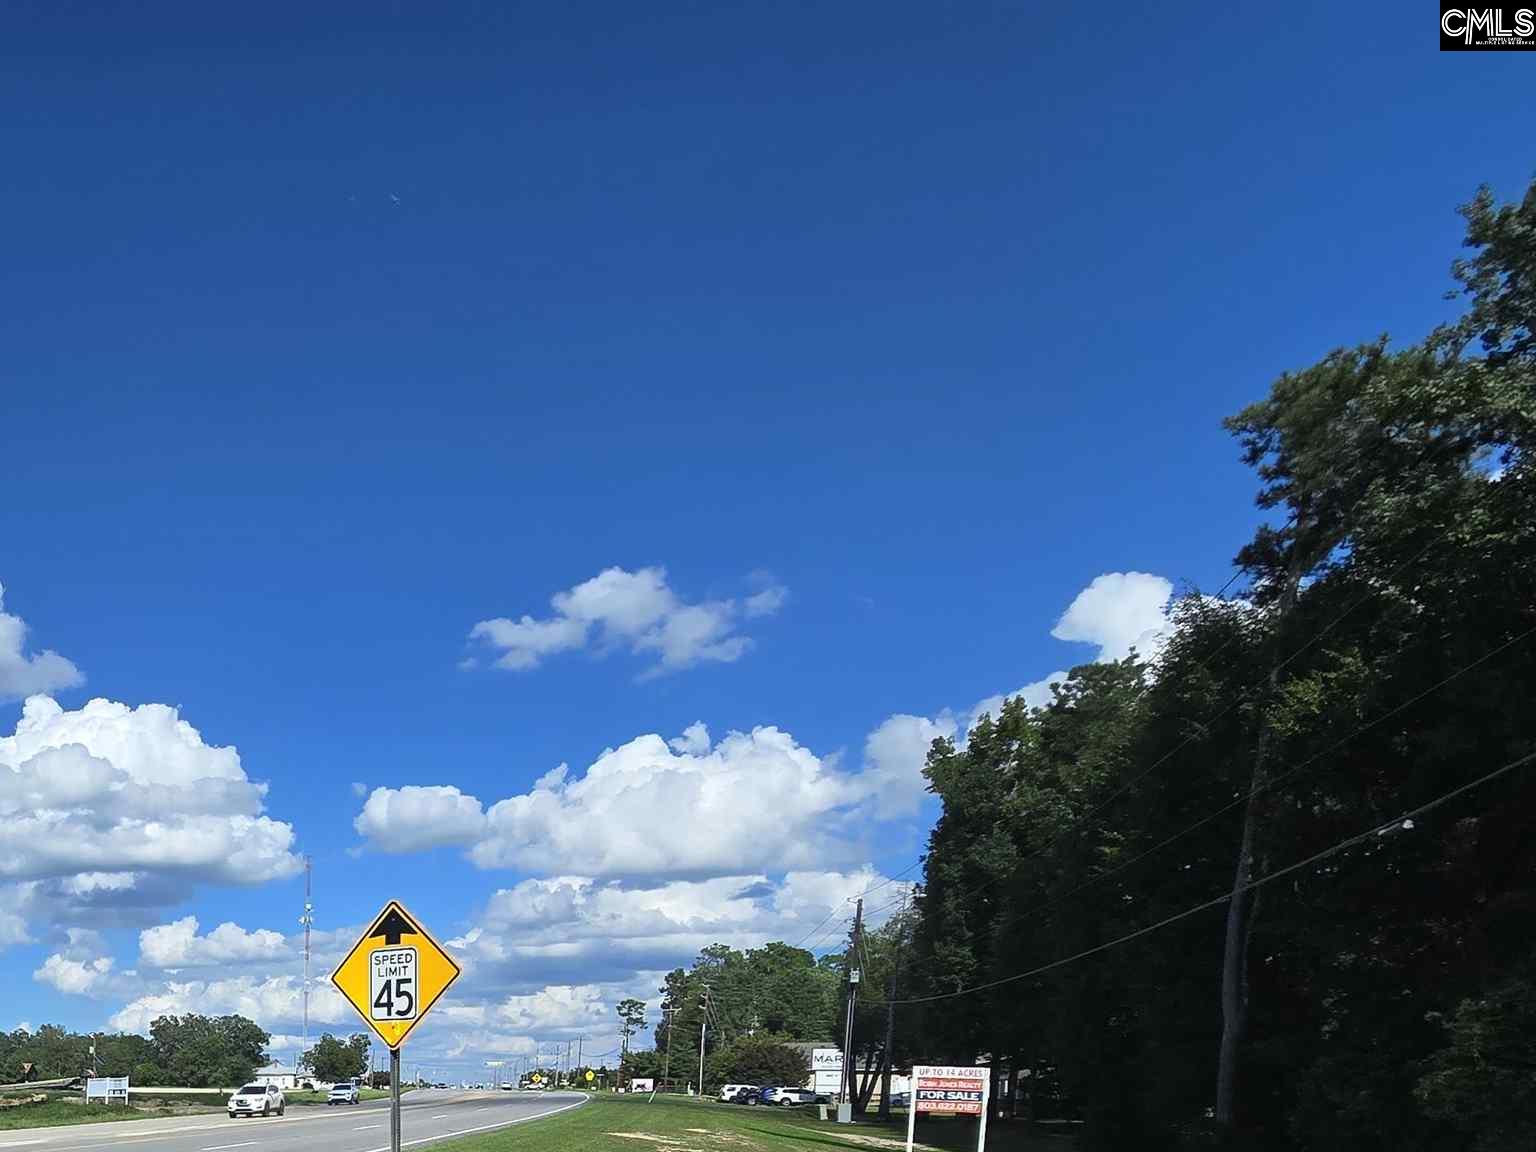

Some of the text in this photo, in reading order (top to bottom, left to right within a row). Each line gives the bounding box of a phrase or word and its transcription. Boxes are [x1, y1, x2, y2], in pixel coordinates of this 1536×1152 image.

[374, 953, 413, 965] SPEED
[377, 965, 409, 978] LIMIT
[373, 978, 414, 1017] 45
[931, 1068, 944, 1076] TO
[958, 1069, 983, 1077] ACRES
[920, 1091, 980, 1101] FOR SALE
